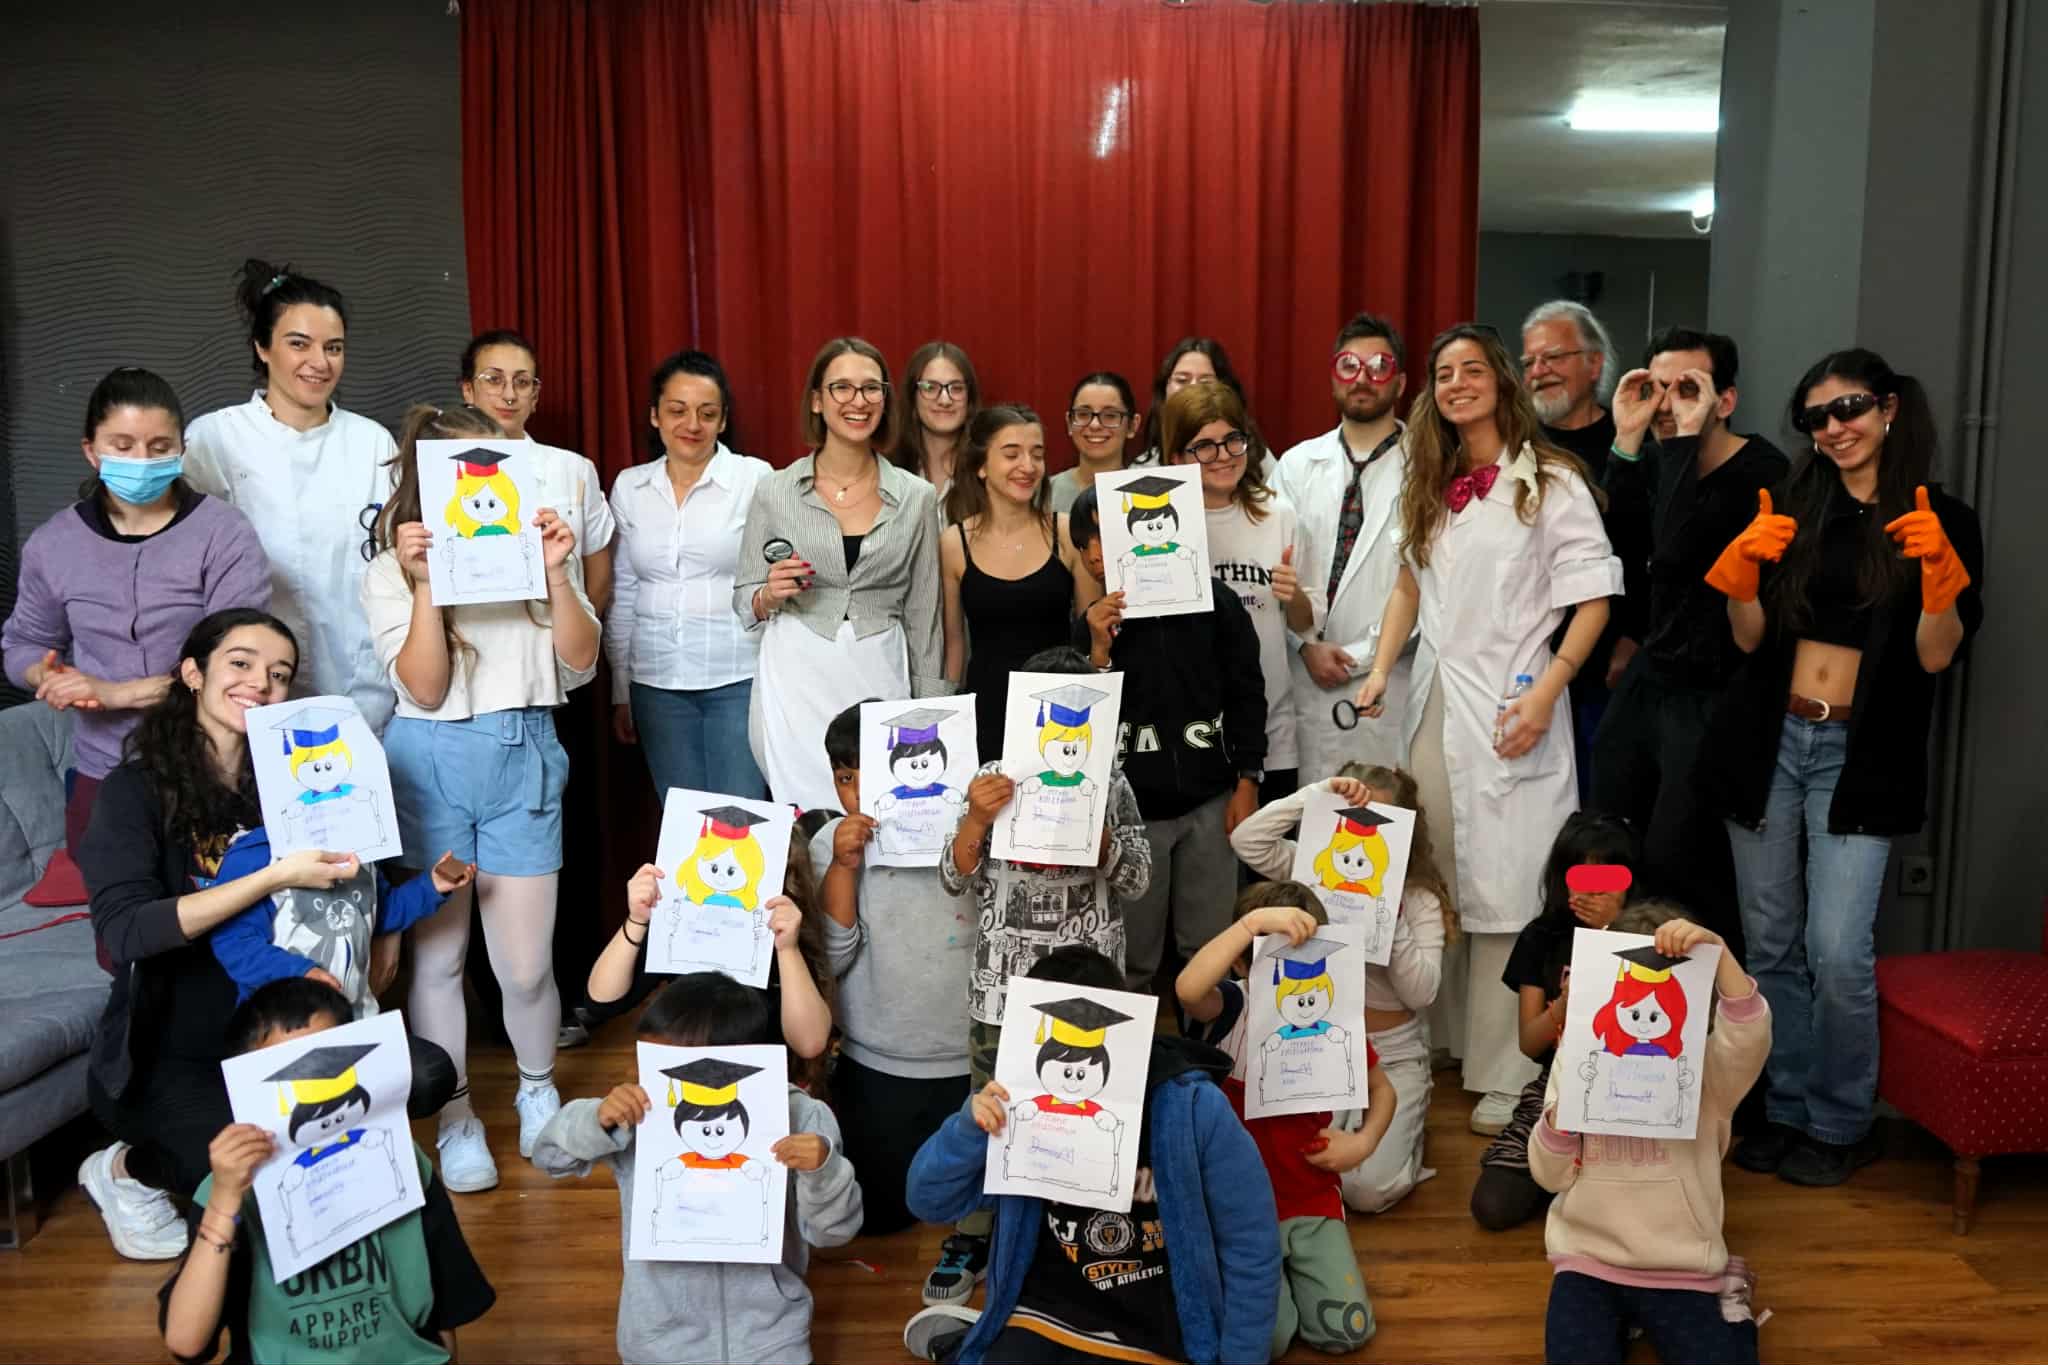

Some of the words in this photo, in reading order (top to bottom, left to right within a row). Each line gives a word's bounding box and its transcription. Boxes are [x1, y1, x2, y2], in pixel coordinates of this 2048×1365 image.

[1056, 908, 1110, 942] COOL
[1087, 1262, 1138, 1280] STYLE
[307, 1317, 381, 1350] SUPPLY
